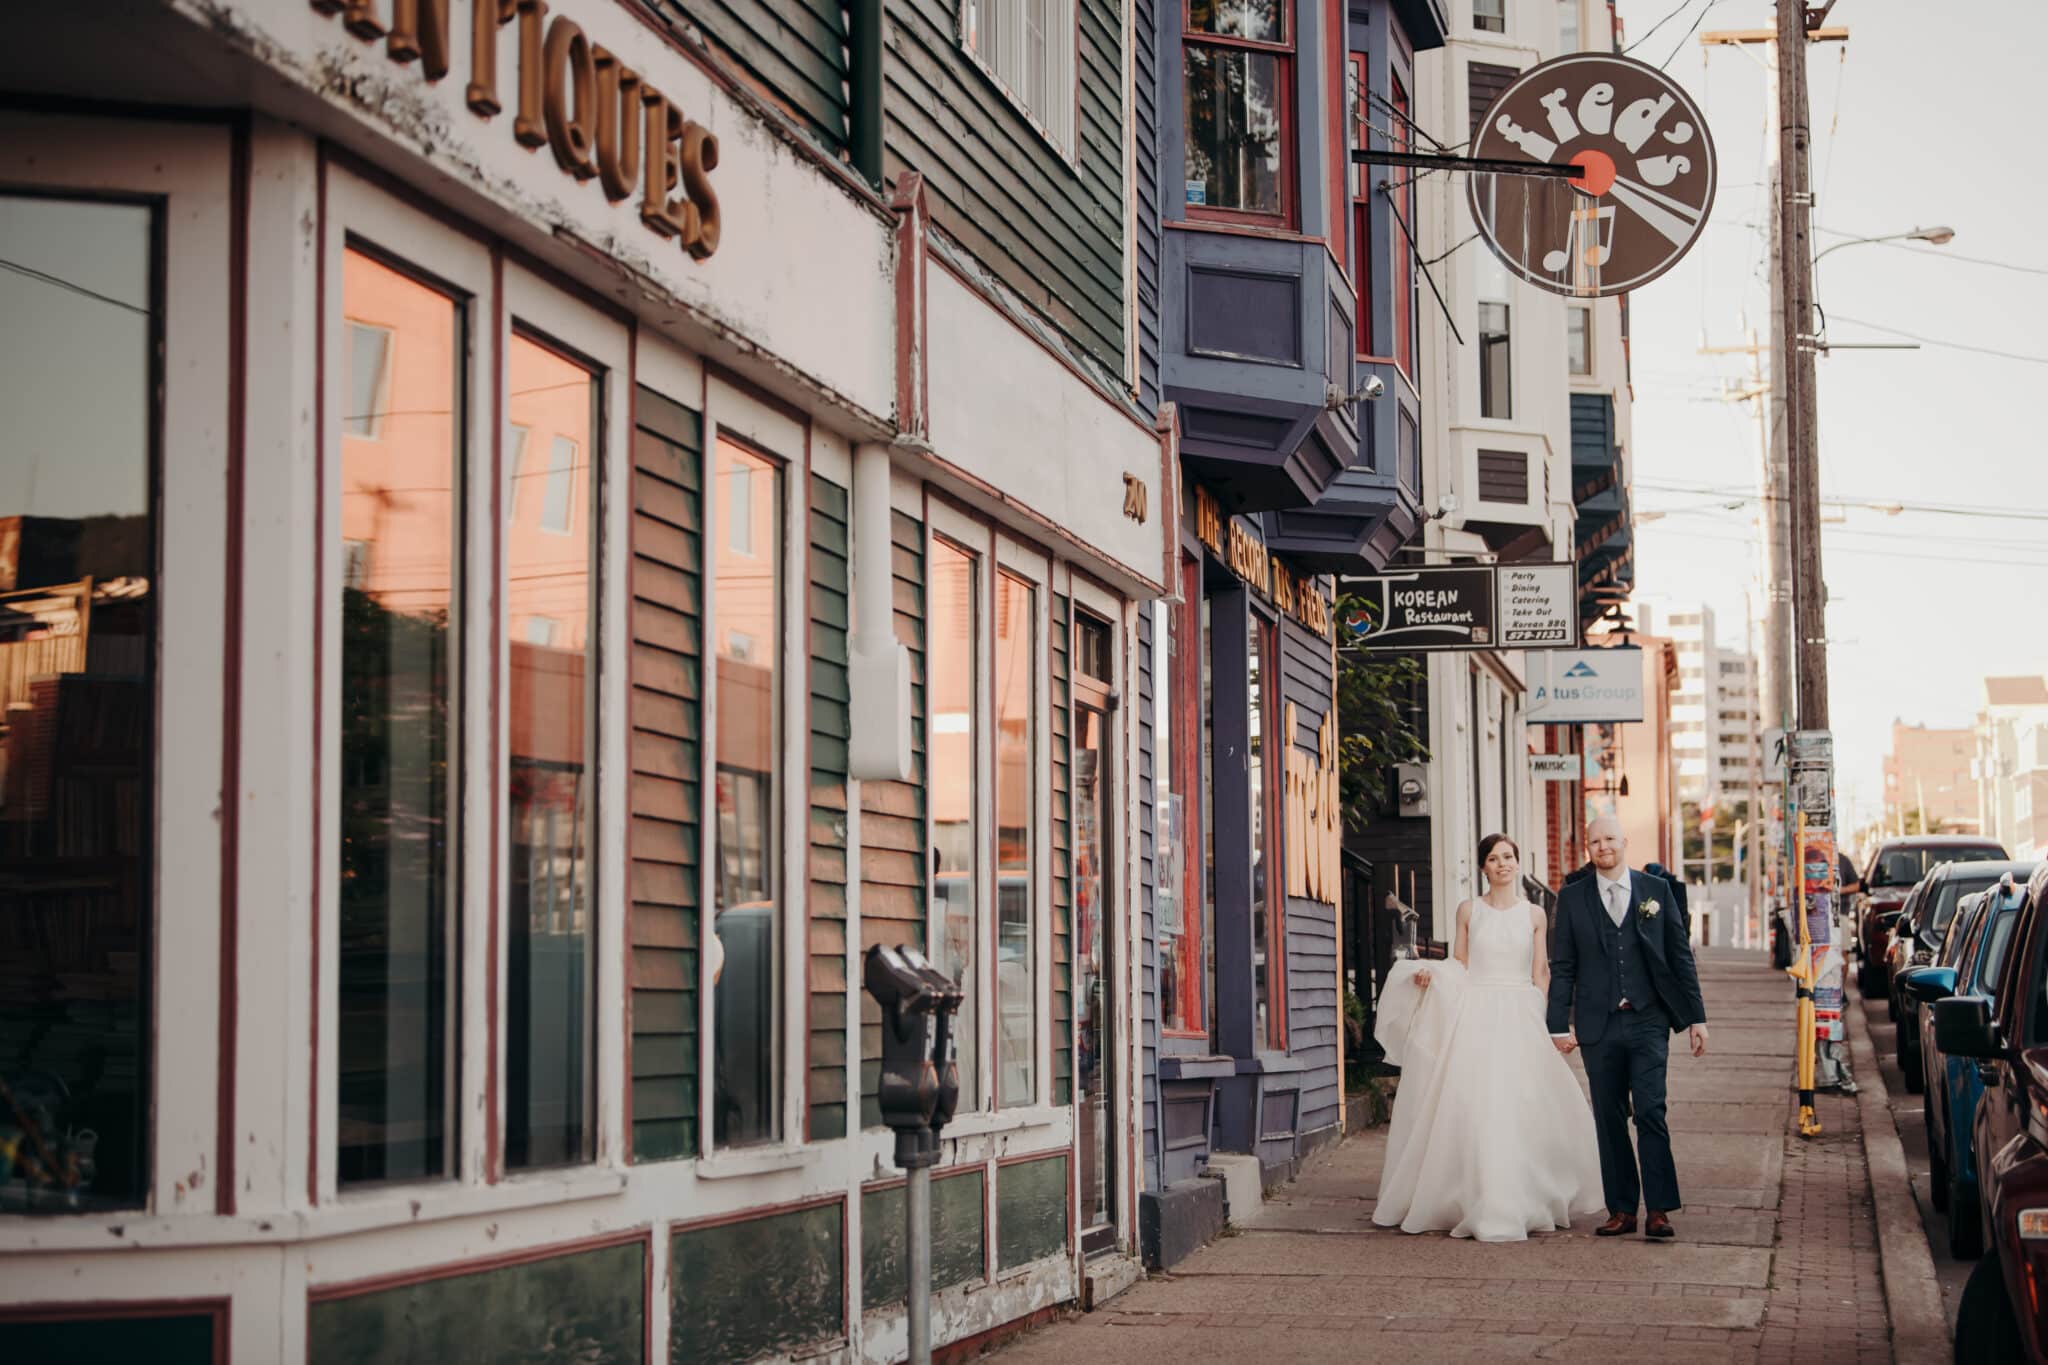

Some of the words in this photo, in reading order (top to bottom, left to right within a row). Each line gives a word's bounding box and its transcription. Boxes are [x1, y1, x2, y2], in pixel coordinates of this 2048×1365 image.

[310, 0, 721, 260] TIQUES
[1511, 572, 1535, 582] Party
[1511, 584, 1540, 593] Dining
[1394, 590, 1458, 608] KOREAN
[1512, 596, 1550, 605] Catering
[1405, 608, 1474, 625] Restaurant
[1536, 608, 1552, 616] Out
